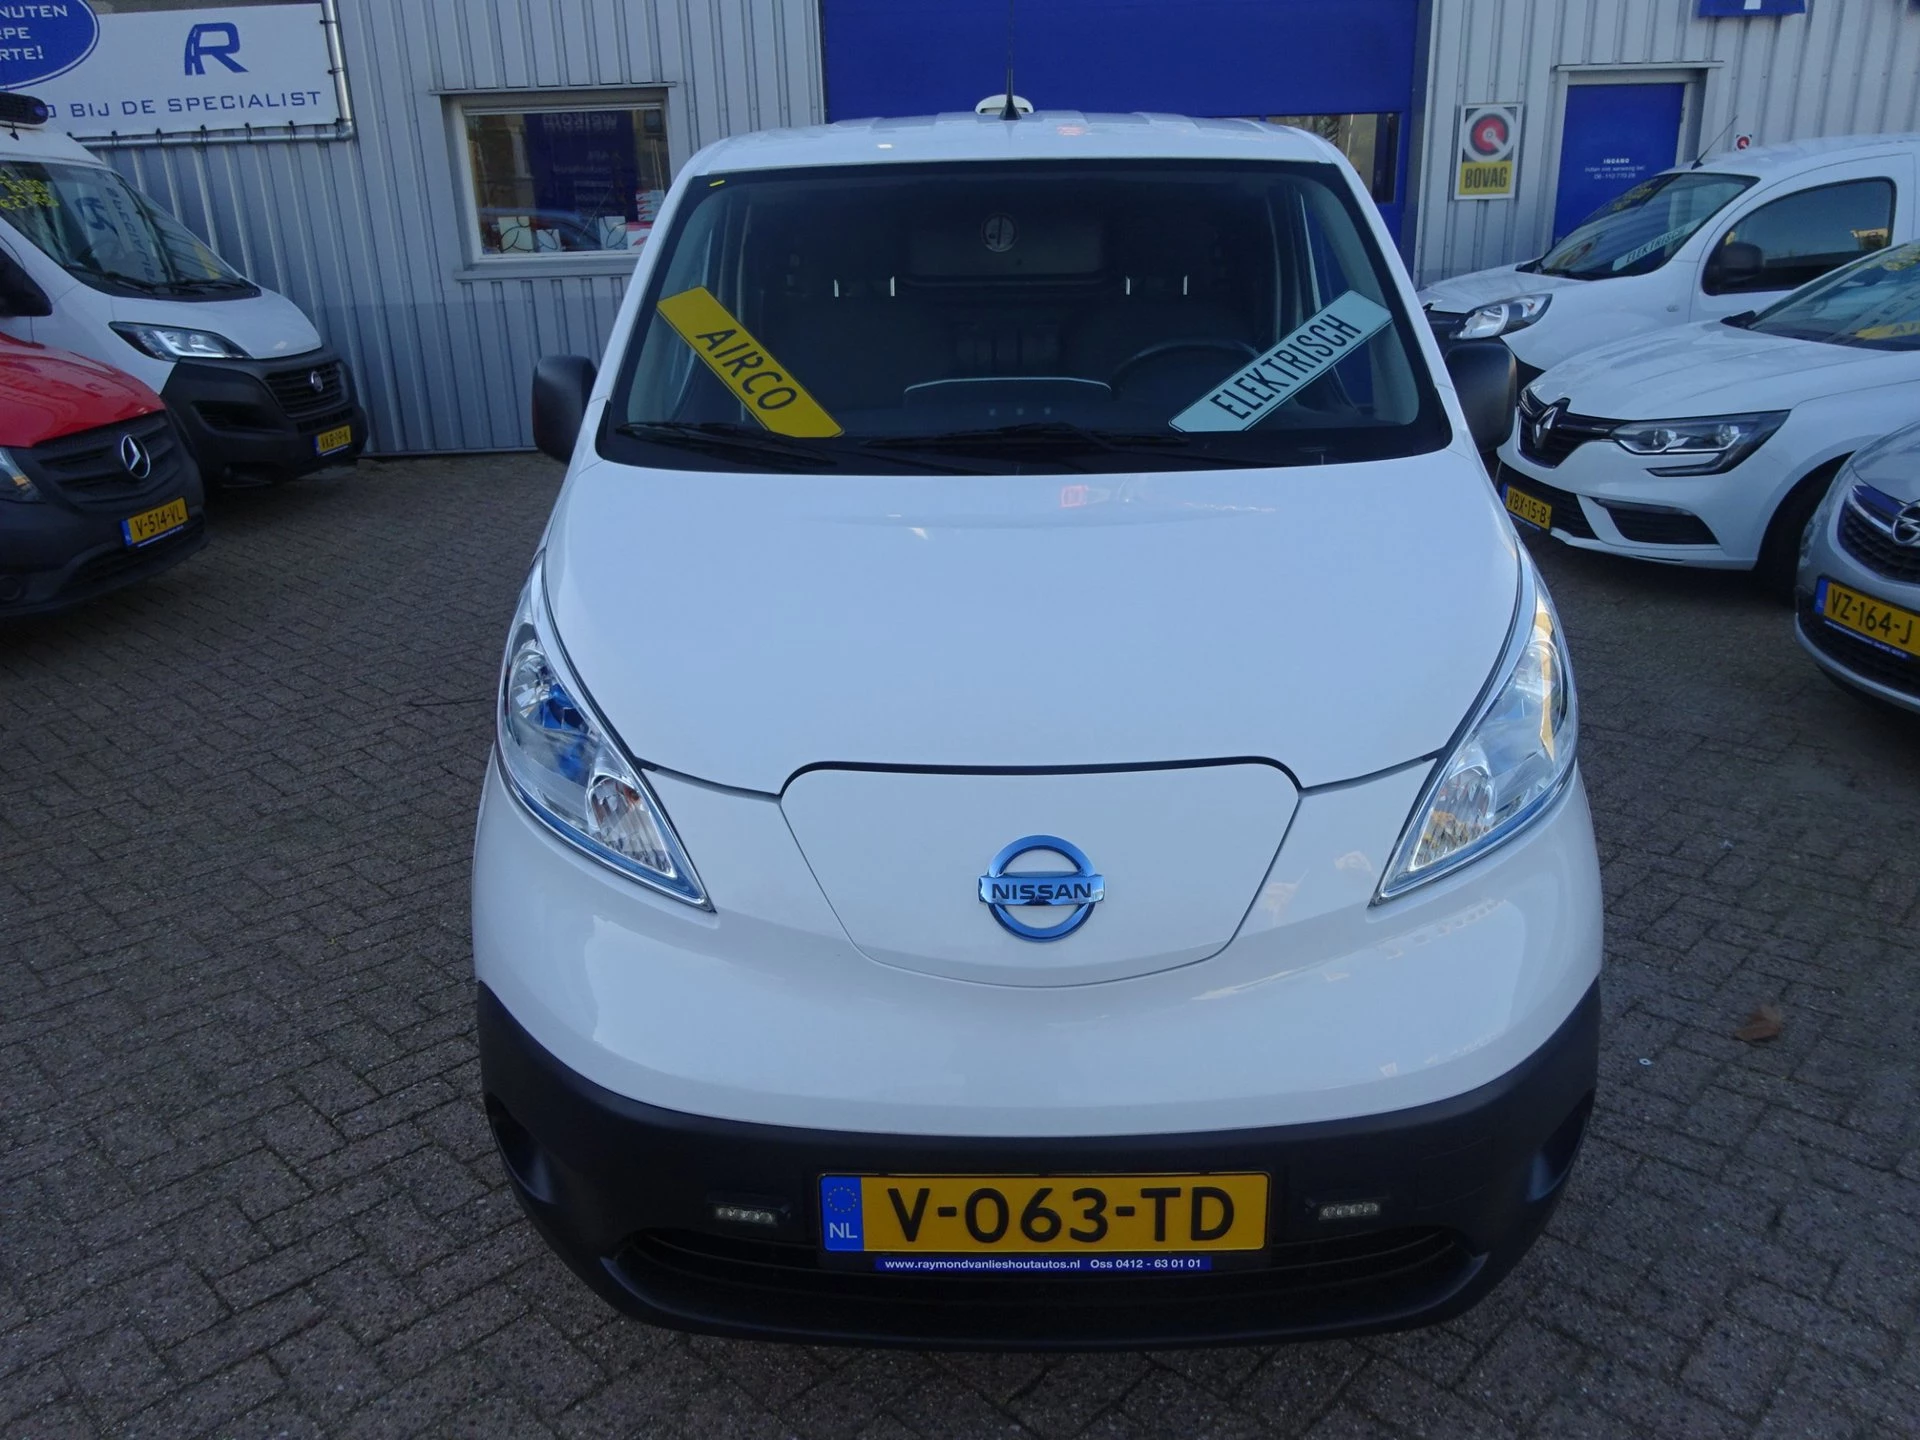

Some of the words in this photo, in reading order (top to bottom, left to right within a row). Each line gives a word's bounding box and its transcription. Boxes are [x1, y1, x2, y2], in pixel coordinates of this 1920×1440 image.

[70, 102, 110, 117] BIJ
[121, 99, 156, 115] DE
[168, 91, 321, 113] SPECIALIST
[1464, 166, 1508, 189] BOVAG
[695, 328, 798, 410] AIRCO
[1209, 313, 1362, 420] ELEKTRISCH
[134, 502, 184, 536] V-514-VL
[1831, 588, 1913, 645] VZ-164-J
[991, 882, 1091, 900] NISSAN
[886, 1187, 1235, 1243] V-063-TD
[828, 1222, 858, 1239] NL
[885, 1259, 1080, 1270] www.raymondvanlieshoutautos.nl
[1090, 1259, 1113, 1269] Oss
[1115, 1259, 1144, 1268] 0412
[1154, 1259, 1169, 1268] 63
[1171, 1259, 1185, 1268] 01
[1187, 1258, 1201, 1268] 01
